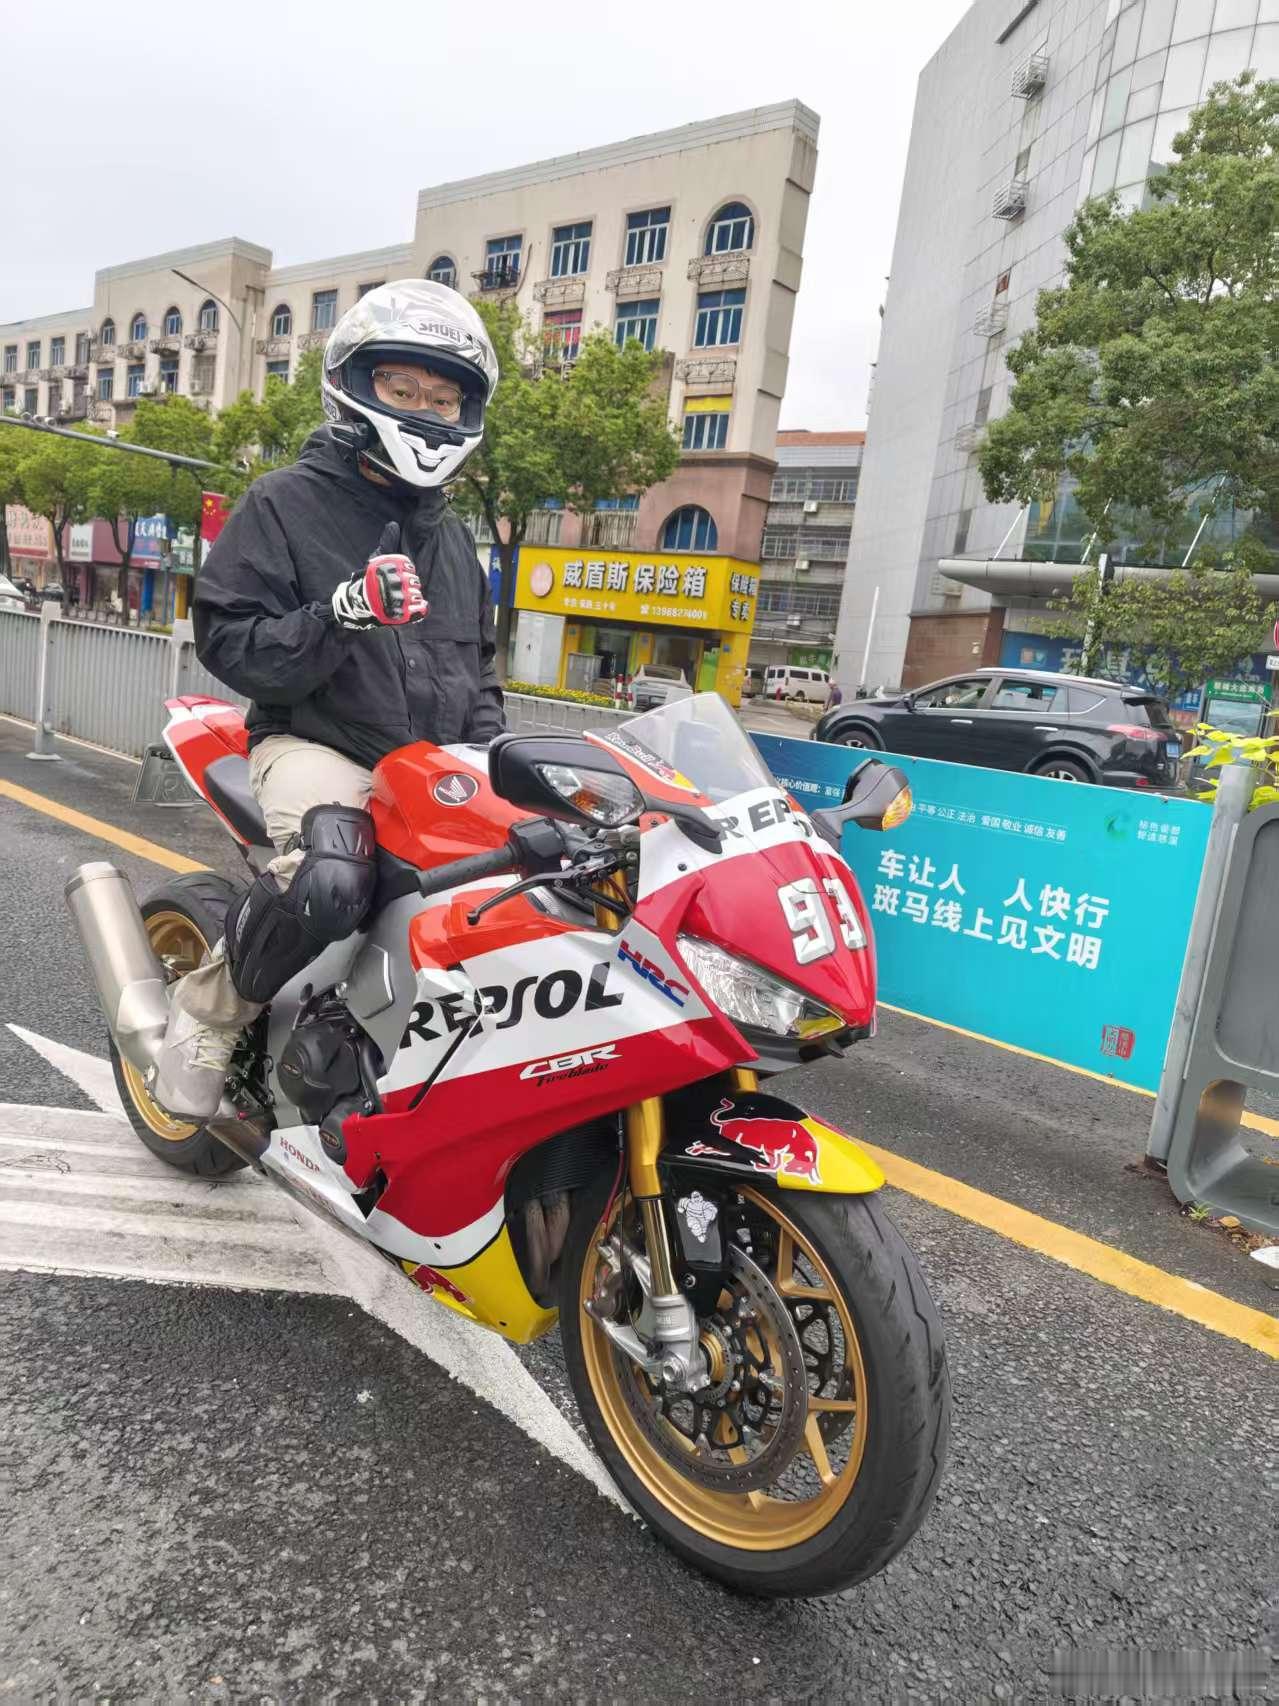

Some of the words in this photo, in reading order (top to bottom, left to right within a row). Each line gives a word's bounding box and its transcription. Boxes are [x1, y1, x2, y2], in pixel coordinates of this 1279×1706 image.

[777, 876, 867, 966] 93
[872, 883, 1103, 971] 斑马线上见文明
[878, 848, 966, 896] 车让人
[1003, 877, 1110, 930] 人快行
[399, 961, 624, 1049] REPSOL
[618, 940, 690, 1008] HRC
[519, 1043, 623, 1080] CBR
